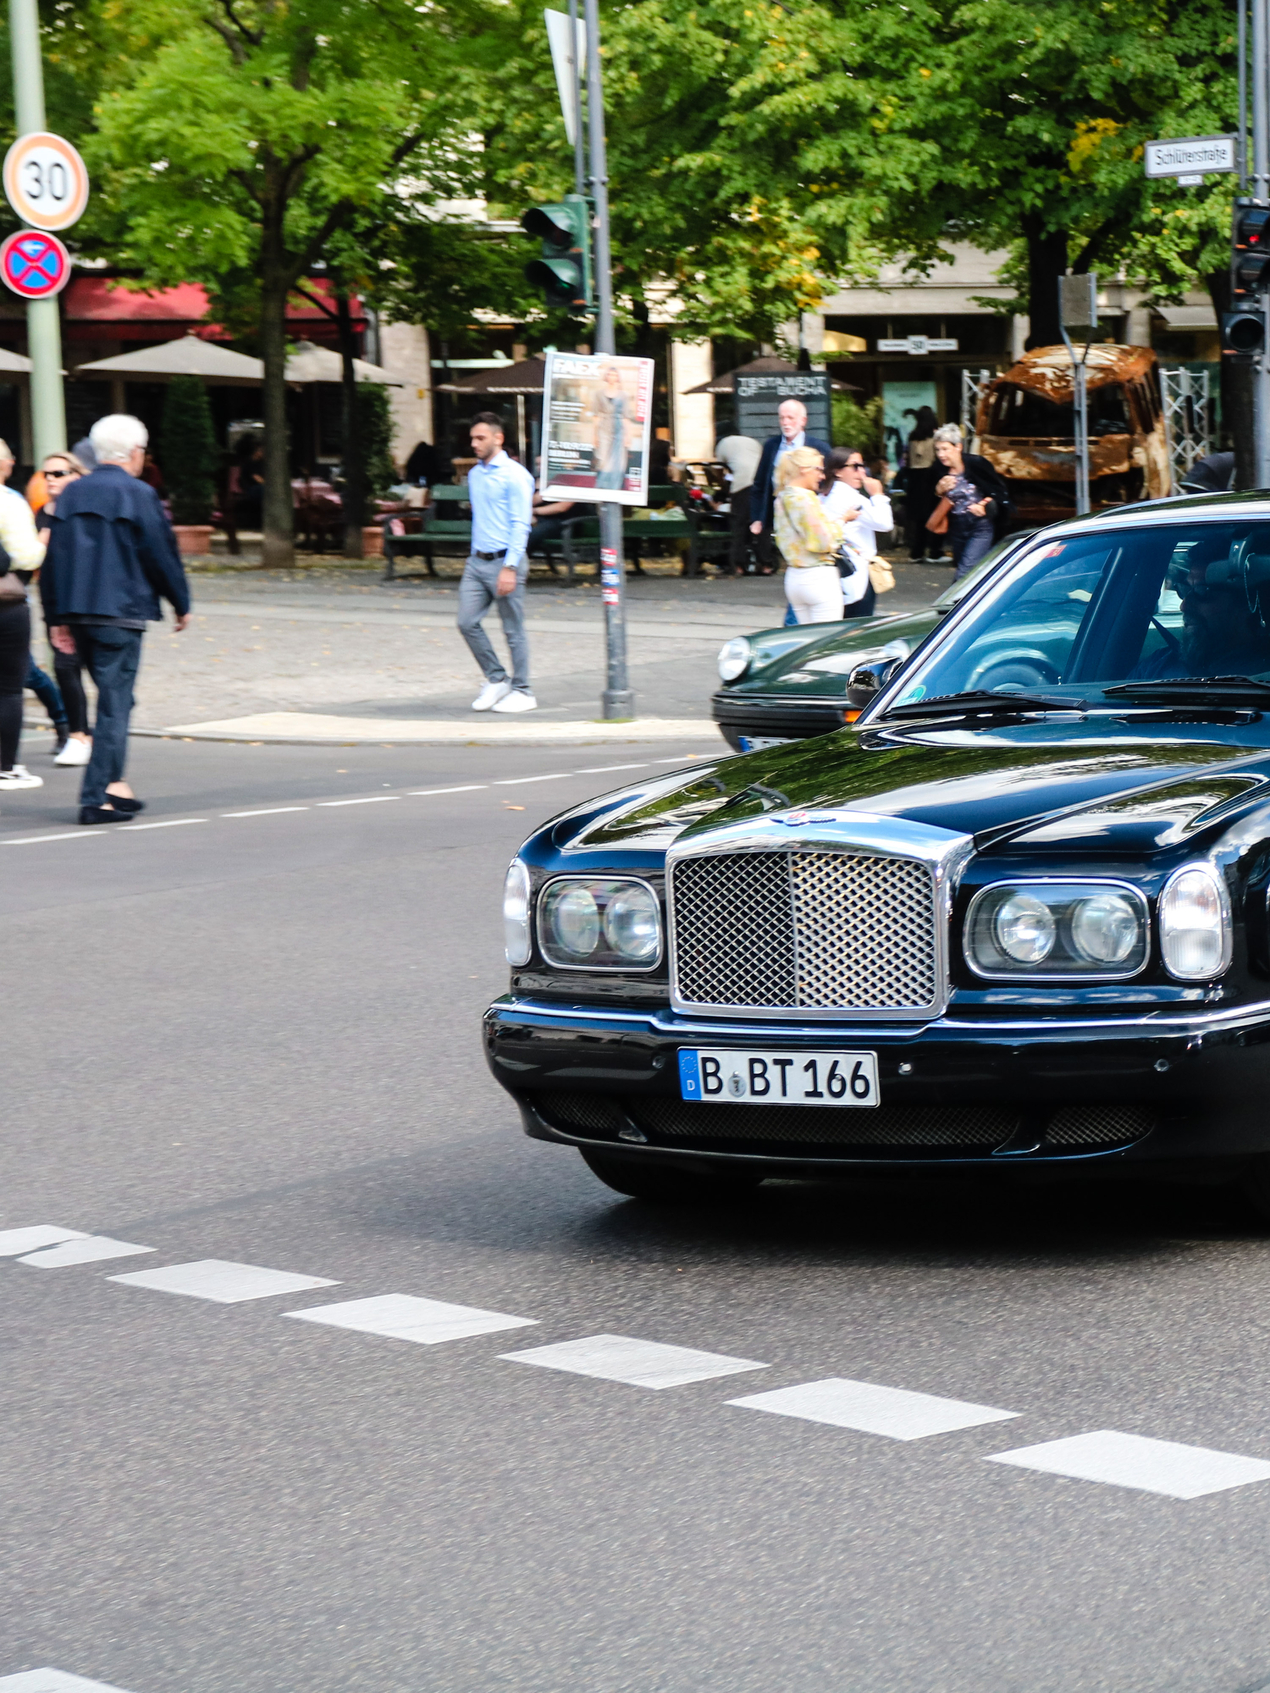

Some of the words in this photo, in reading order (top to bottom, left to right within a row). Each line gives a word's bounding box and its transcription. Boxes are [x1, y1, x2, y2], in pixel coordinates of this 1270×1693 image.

[1154, 144, 1228, 166] Schlüterstraße
[25, 160, 67, 201] 30
[737, 376, 827, 388] TESTAMENT
[737, 387, 759, 397] OF
[776, 386, 828, 396] BUCHA
[686, 1079, 696, 1091] D
[701, 1056, 723, 1095] B
[748, 1057, 794, 1097] BT
[803, 1059, 870, 1099] 166
